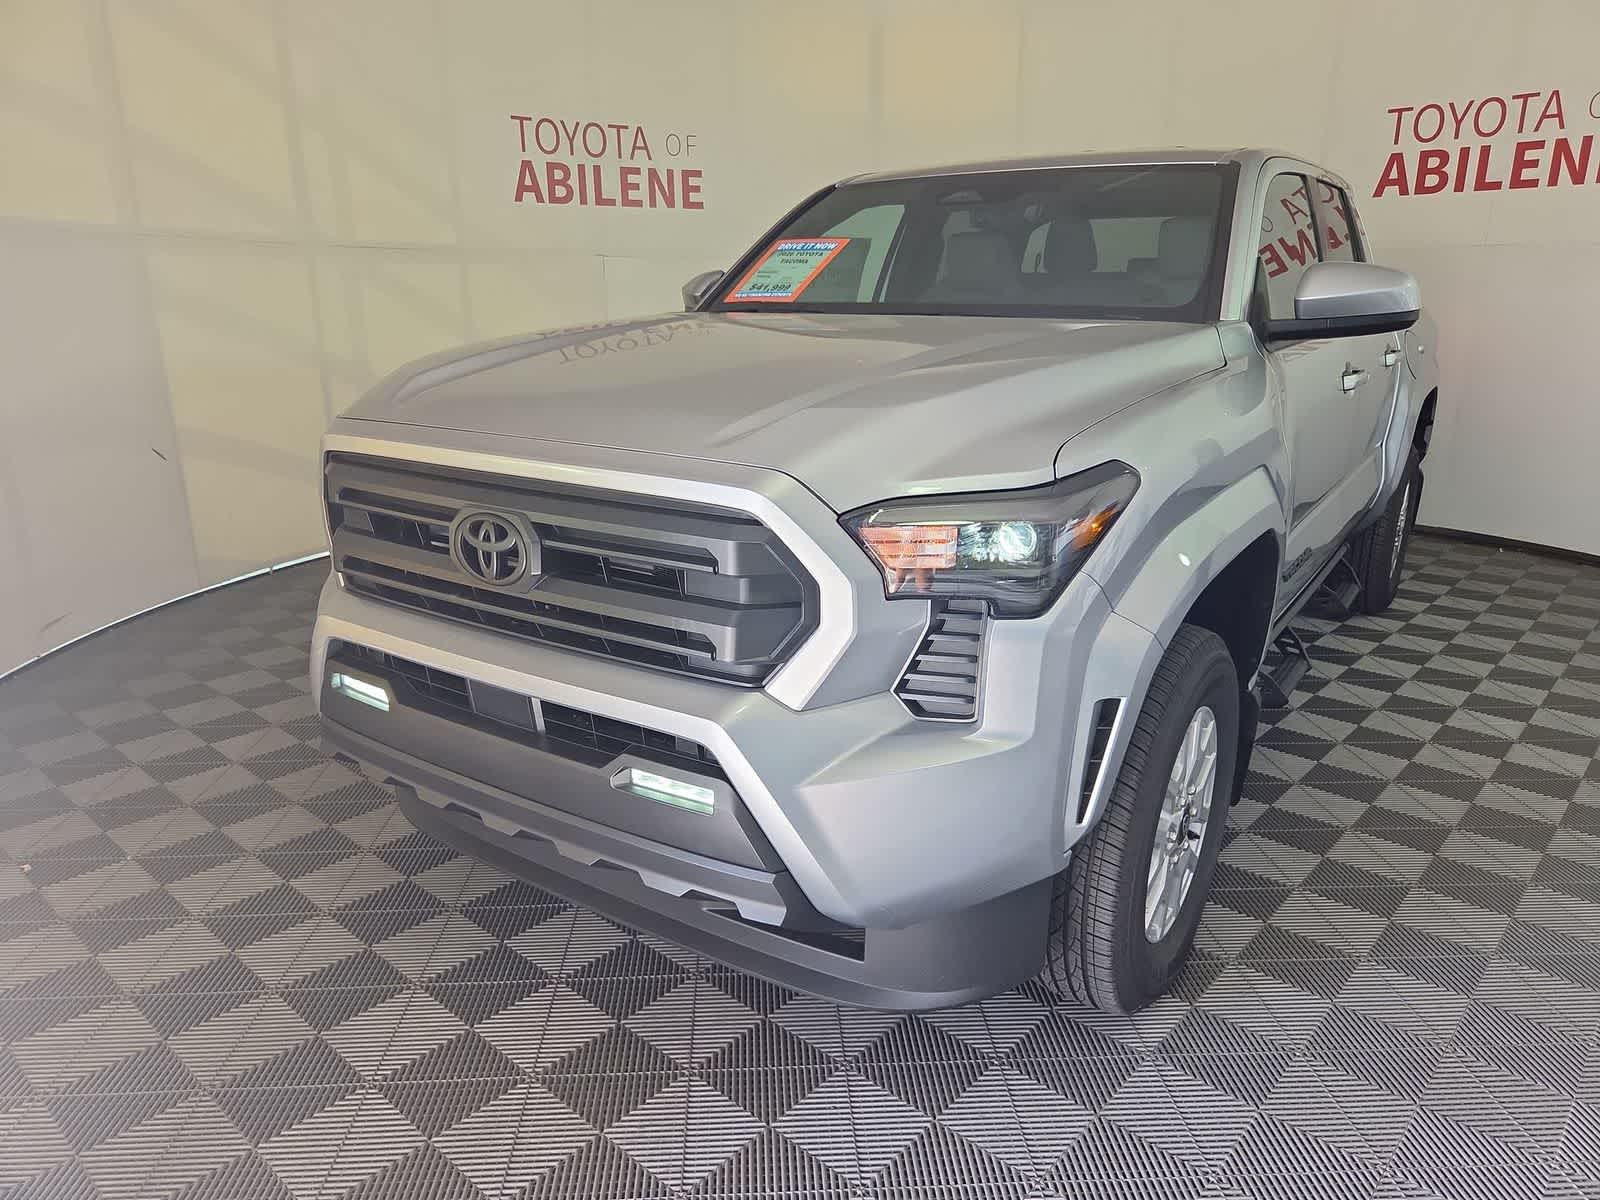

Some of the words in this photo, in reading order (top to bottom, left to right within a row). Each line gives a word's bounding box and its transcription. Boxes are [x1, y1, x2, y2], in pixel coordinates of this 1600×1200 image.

[510, 115, 652, 160] TOYOTA
[665, 133, 697, 156] OF
[1387, 90, 1565, 145] TOYOTA
[514, 160, 704, 209] ABILENE
[1372, 134, 1600, 198] ABILEN
[813, 242, 838, 250] NOW
